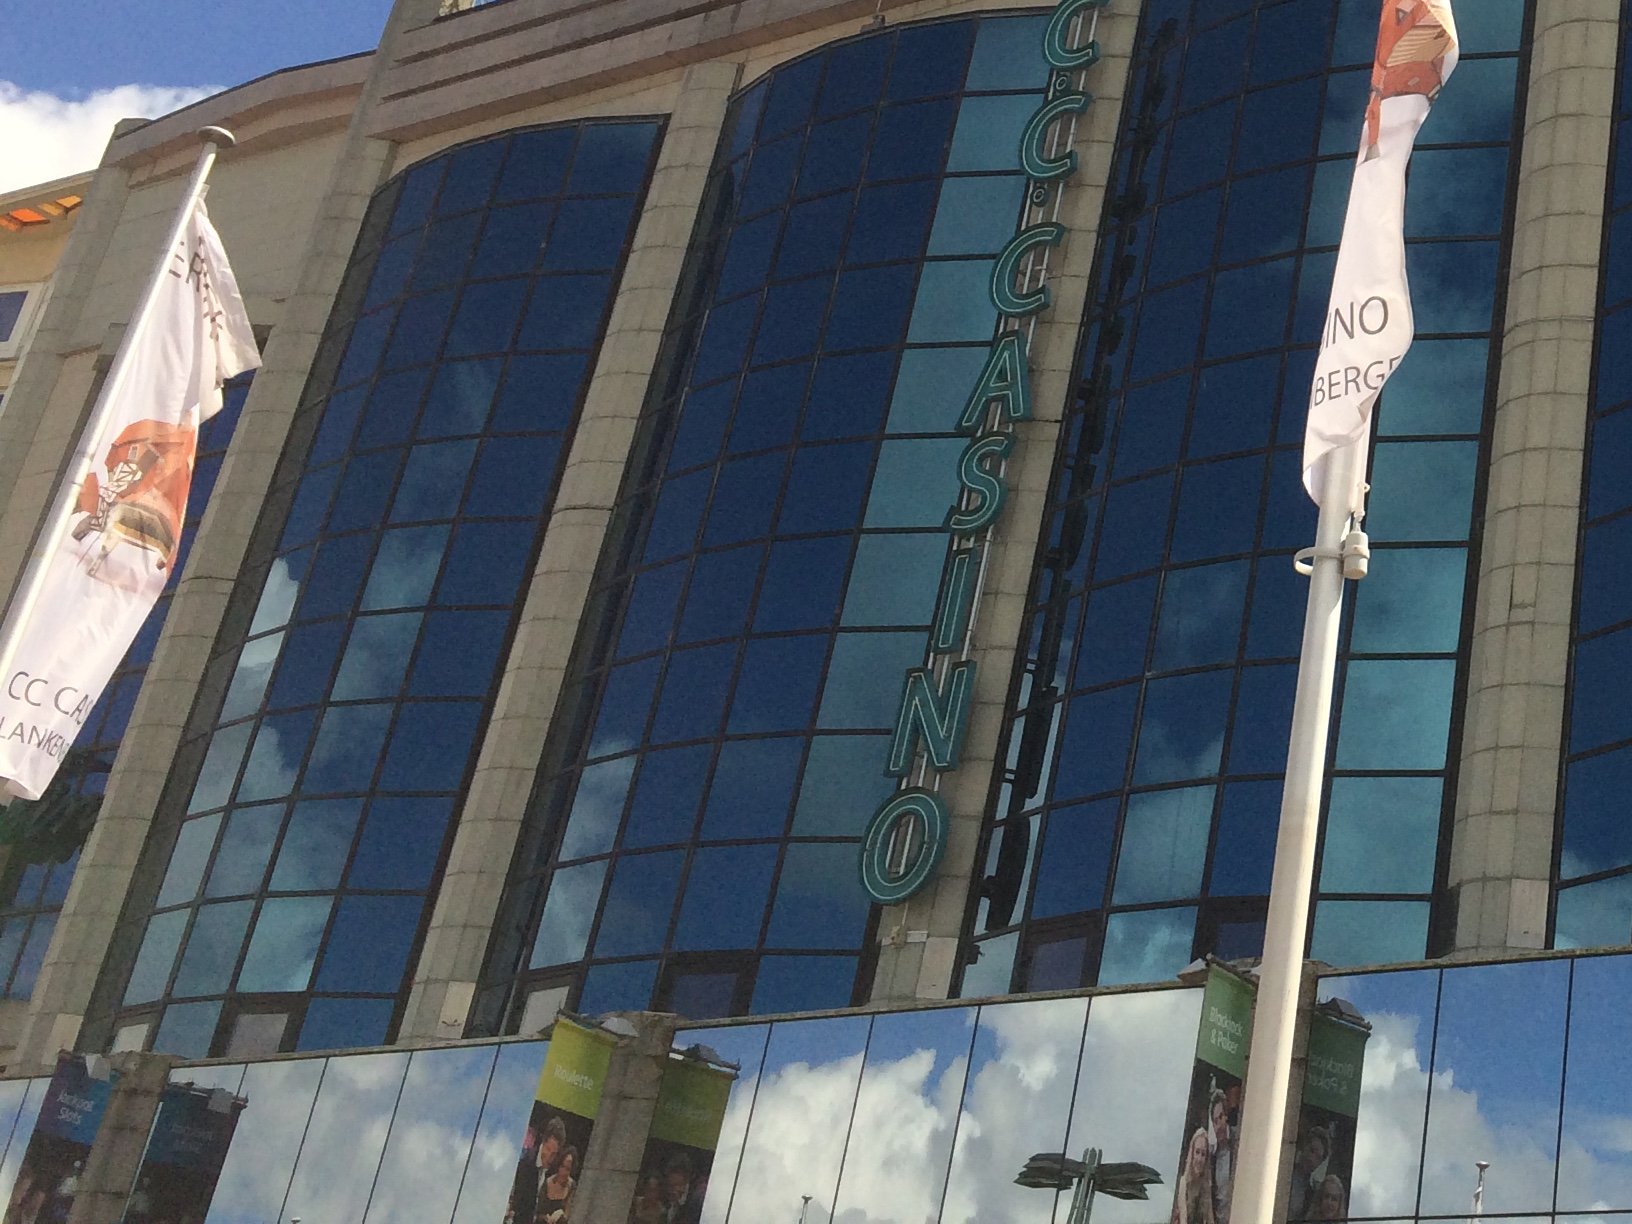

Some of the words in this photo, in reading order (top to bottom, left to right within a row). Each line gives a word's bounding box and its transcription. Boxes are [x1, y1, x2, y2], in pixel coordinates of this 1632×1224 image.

[1320, 296, 1388, 353] INO
[1309, 355, 1401, 410] BERG
[859, 223, 1066, 904] CASINO
[8, 671, 48, 707] CC
[1209, 1006, 1243, 1037] Blackjack
[1210, 1028, 1217, 1046] &
[1217, 1031, 1239, 1055] Poker
